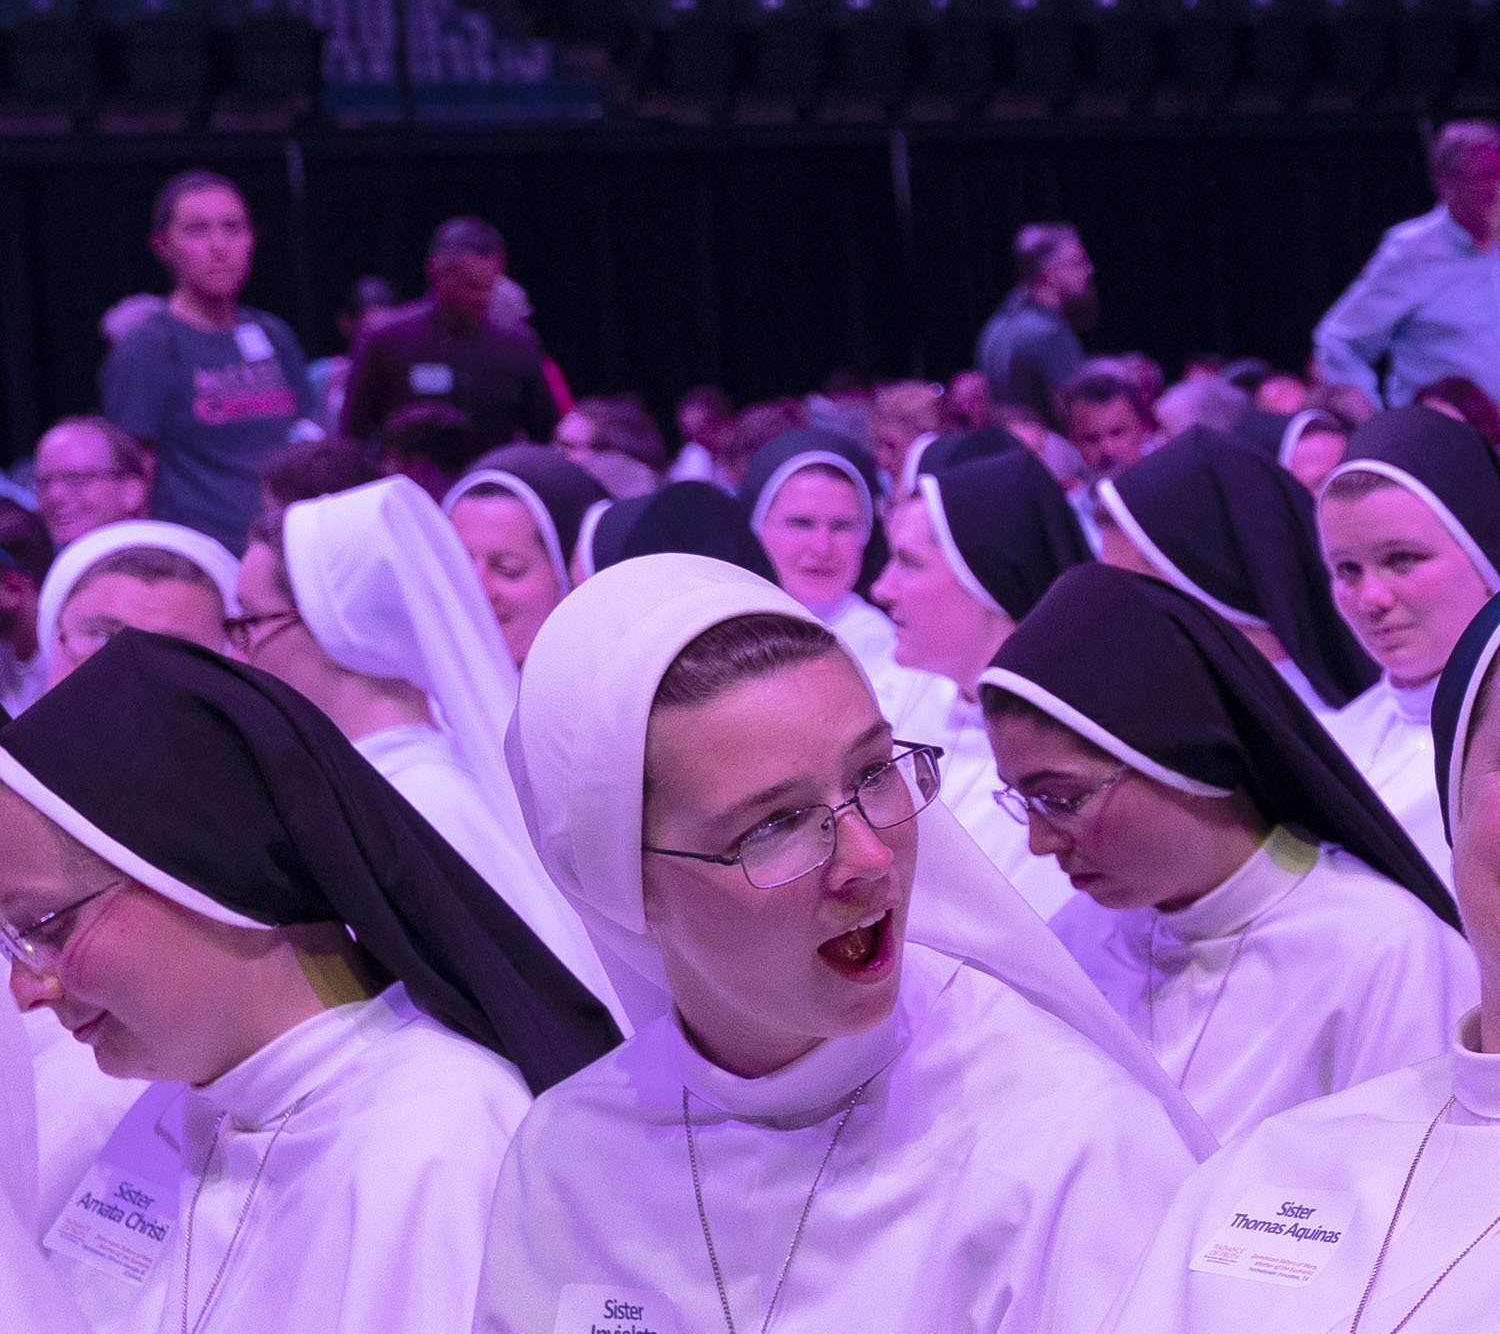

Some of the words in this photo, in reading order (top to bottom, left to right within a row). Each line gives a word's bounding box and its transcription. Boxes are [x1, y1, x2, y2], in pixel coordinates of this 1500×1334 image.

[114, 1181, 155, 1209] Sister
[77, 1191, 124, 1223] Amata
[125, 1212, 170, 1242] Christi
[1276, 1201, 1316, 1219] Sister
[1230, 1213, 1286, 1235] Thomas
[1286, 1223, 1342, 1243] Aquinas
[604, 1299, 644, 1320] Sister
